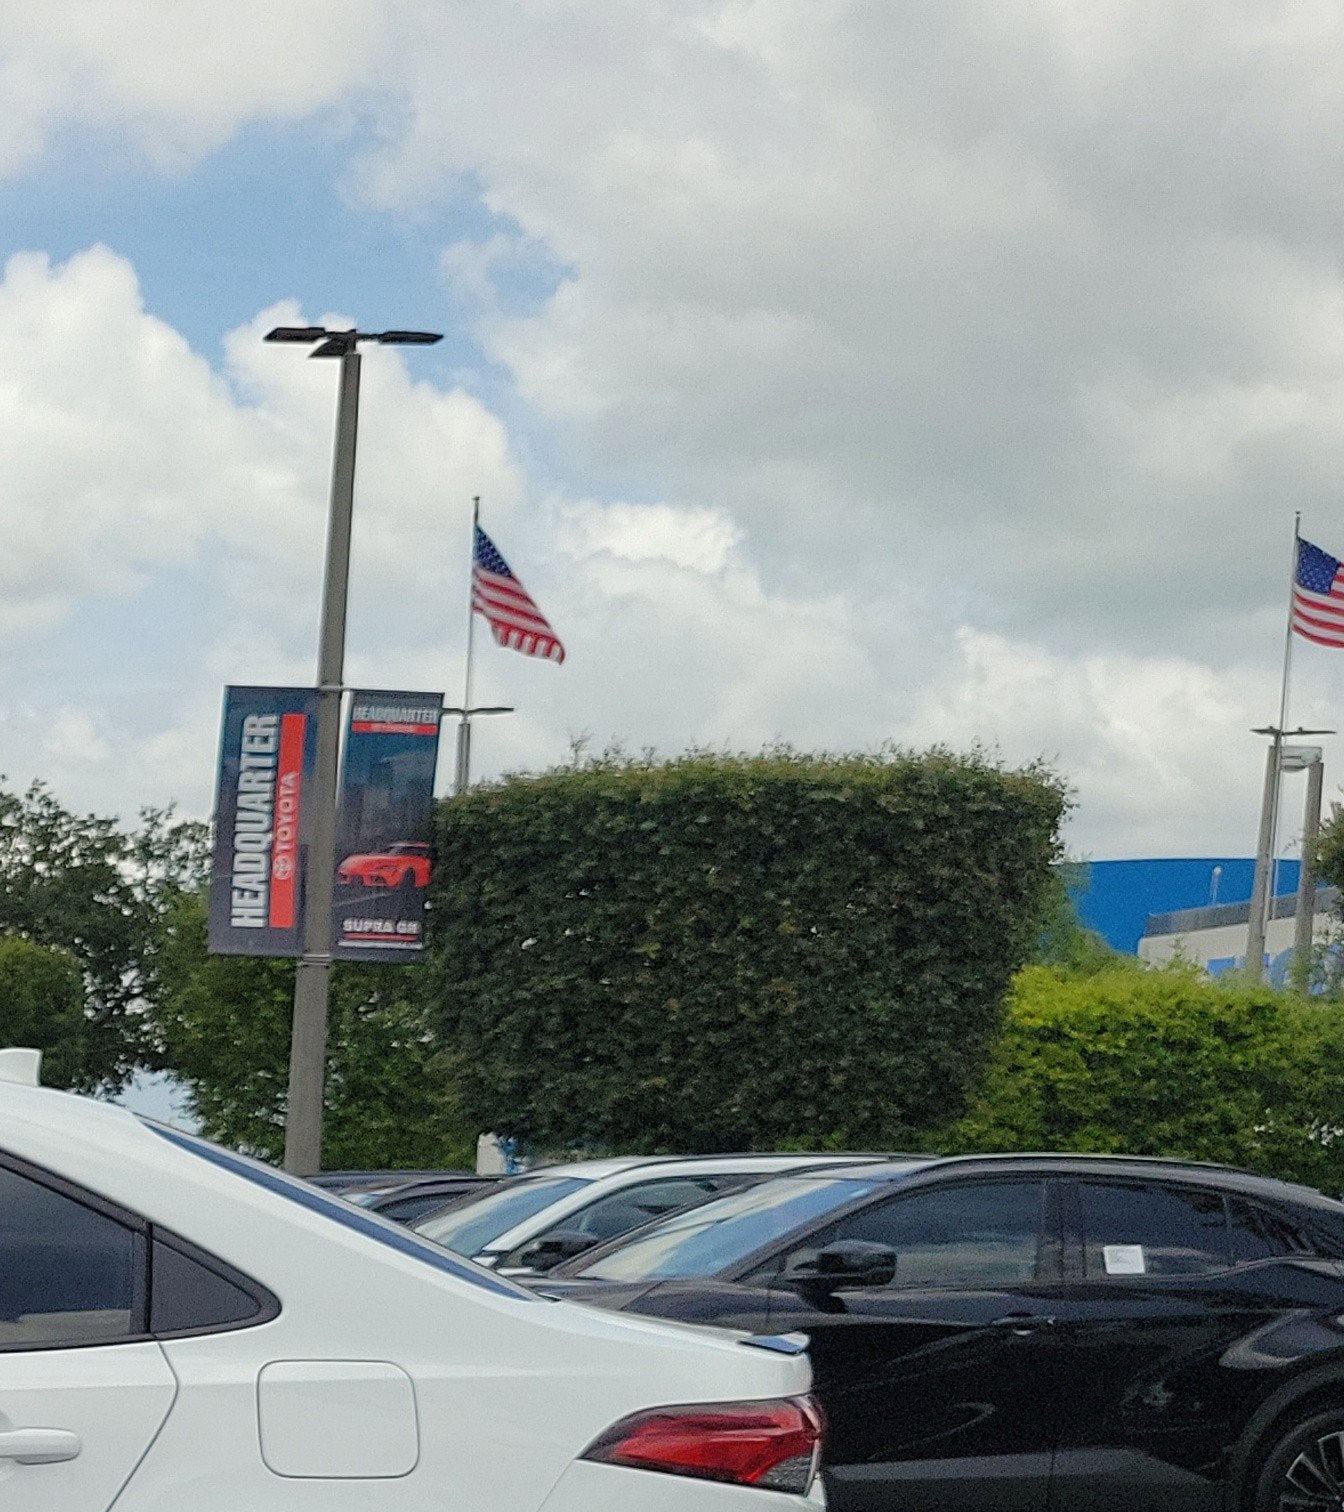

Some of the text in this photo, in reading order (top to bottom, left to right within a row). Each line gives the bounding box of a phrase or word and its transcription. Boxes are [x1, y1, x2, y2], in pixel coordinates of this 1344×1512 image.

[230, 715, 279, 928] HEADQUARTER
[276, 771, 300, 851] TOYOTA
[342, 918, 394, 933] SUPRA
